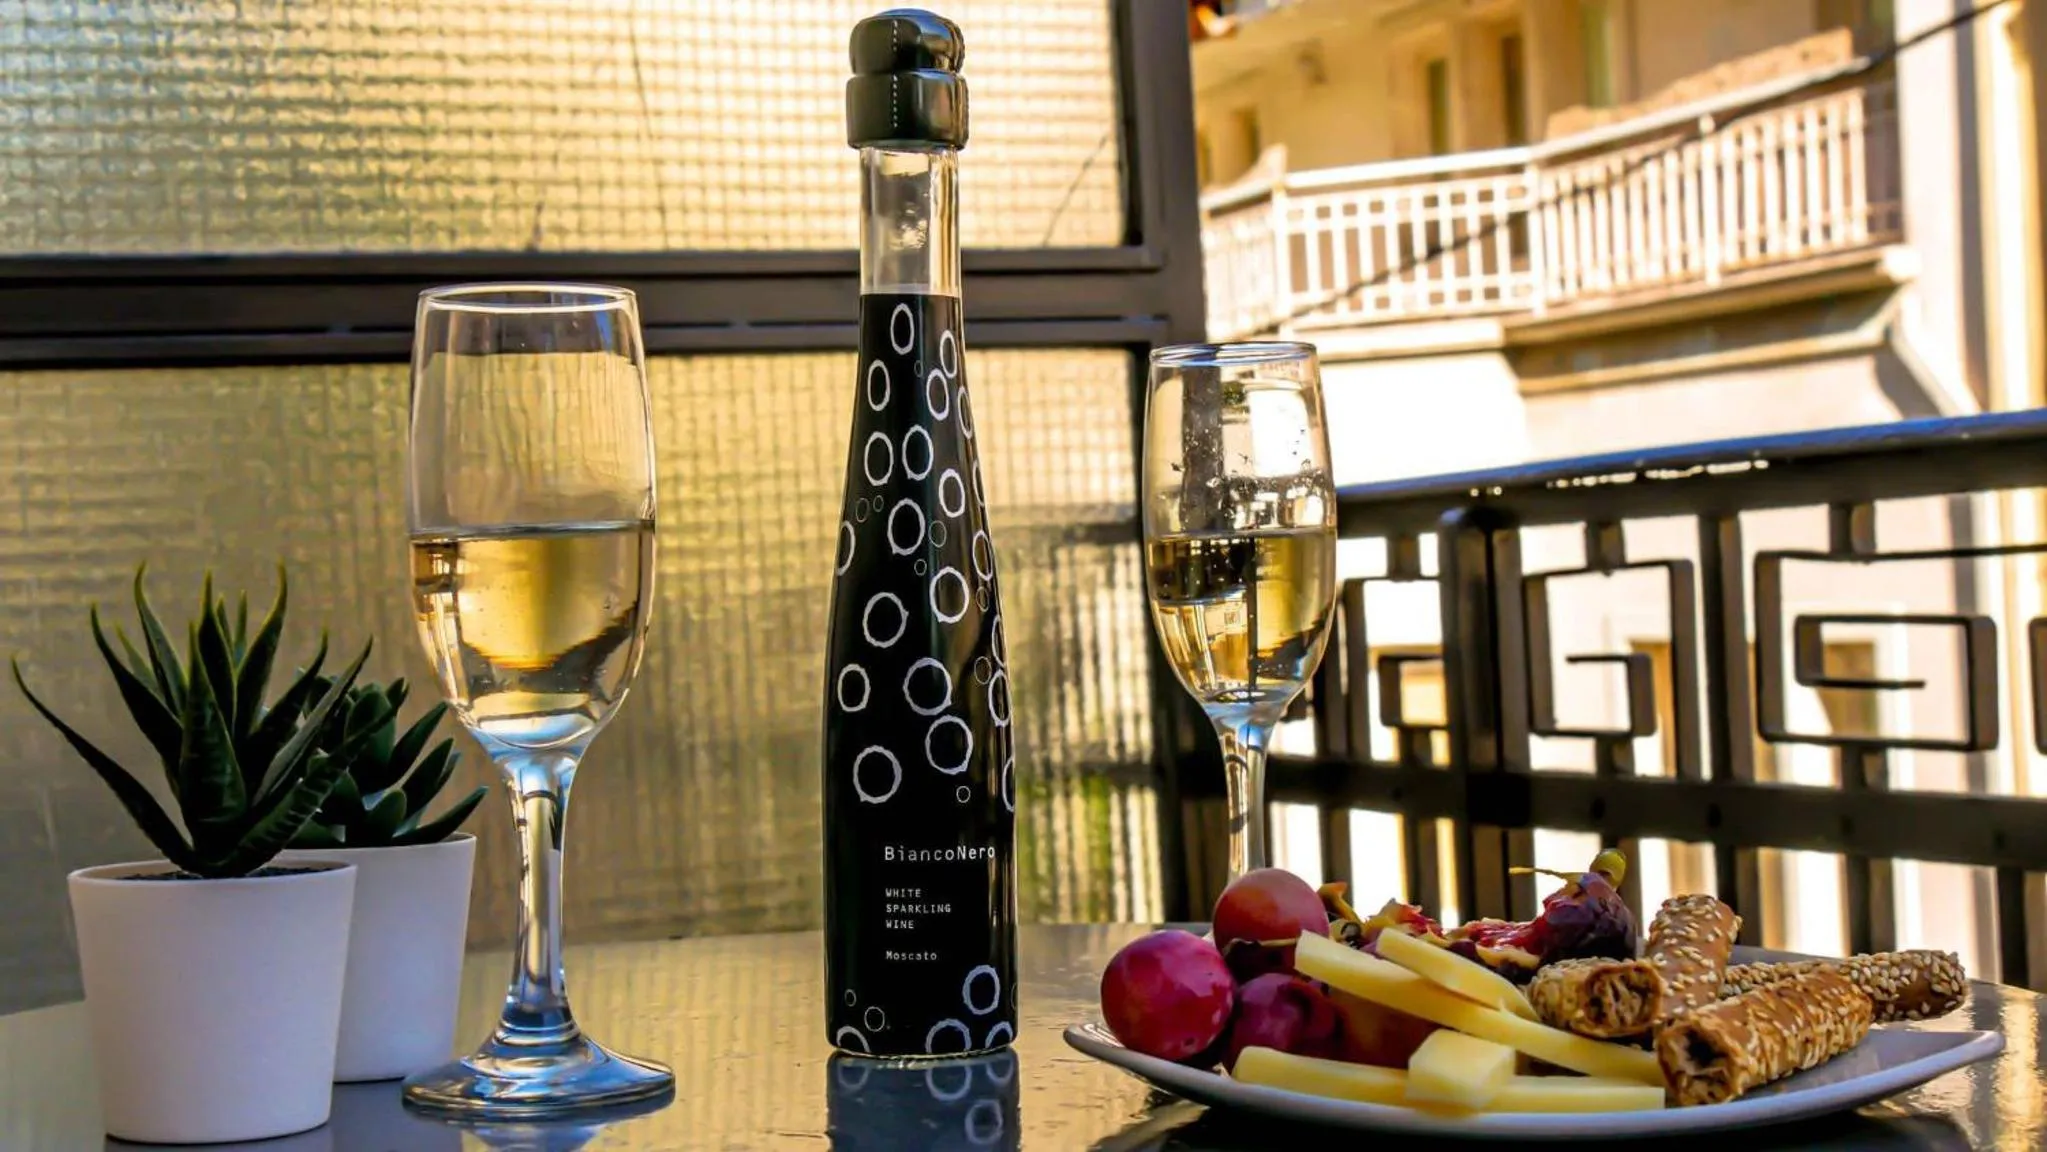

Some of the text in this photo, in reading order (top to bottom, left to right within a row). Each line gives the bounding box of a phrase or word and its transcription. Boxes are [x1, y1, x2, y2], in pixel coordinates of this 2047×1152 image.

[884, 845, 996, 862] BiancoNero
[885, 888, 922, 898] WHITE
[885, 904, 952, 914] SPARKLING
[885, 919, 915, 929] WINE
[885, 950, 938, 961] Moscato
